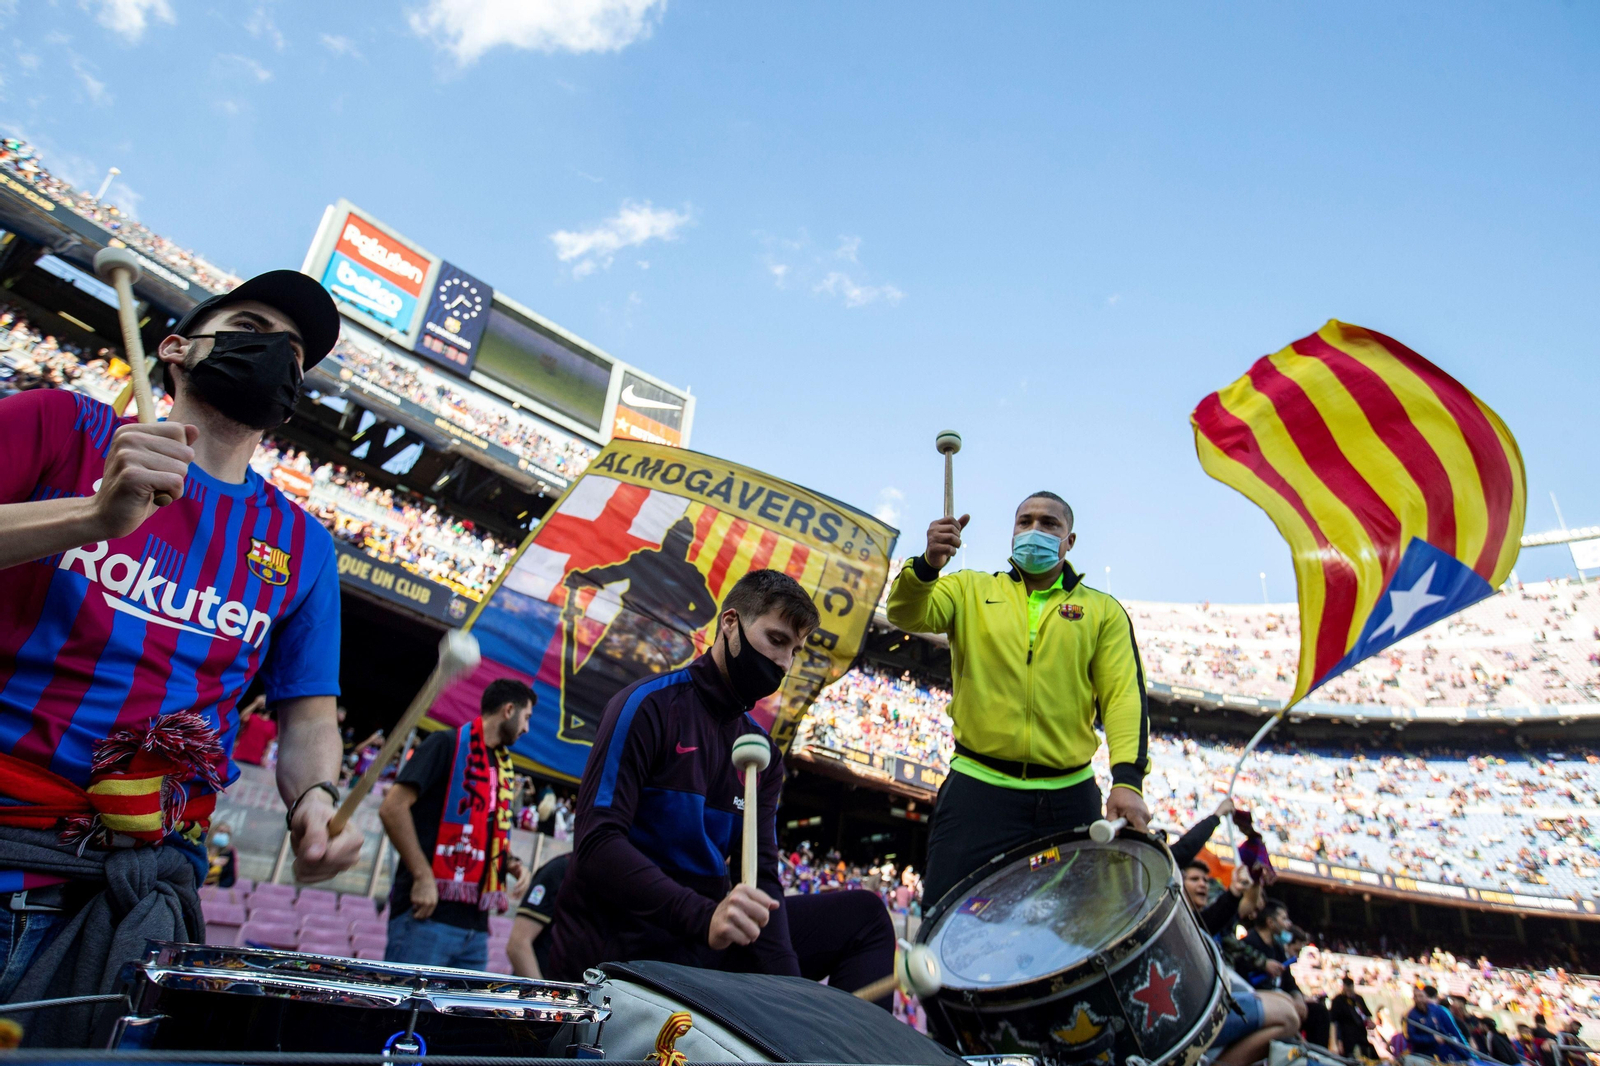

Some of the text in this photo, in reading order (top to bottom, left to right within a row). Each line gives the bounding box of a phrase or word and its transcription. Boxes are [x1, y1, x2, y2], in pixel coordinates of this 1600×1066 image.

[343, 223, 423, 285] Rakuten
[336, 260, 403, 313] beko
[593, 452, 843, 543] ALMOGÀVERS
[58, 539, 272, 650] Rakuten
[338, 553, 432, 605] QUE UN CLUB
[823, 559, 864, 617] FC
